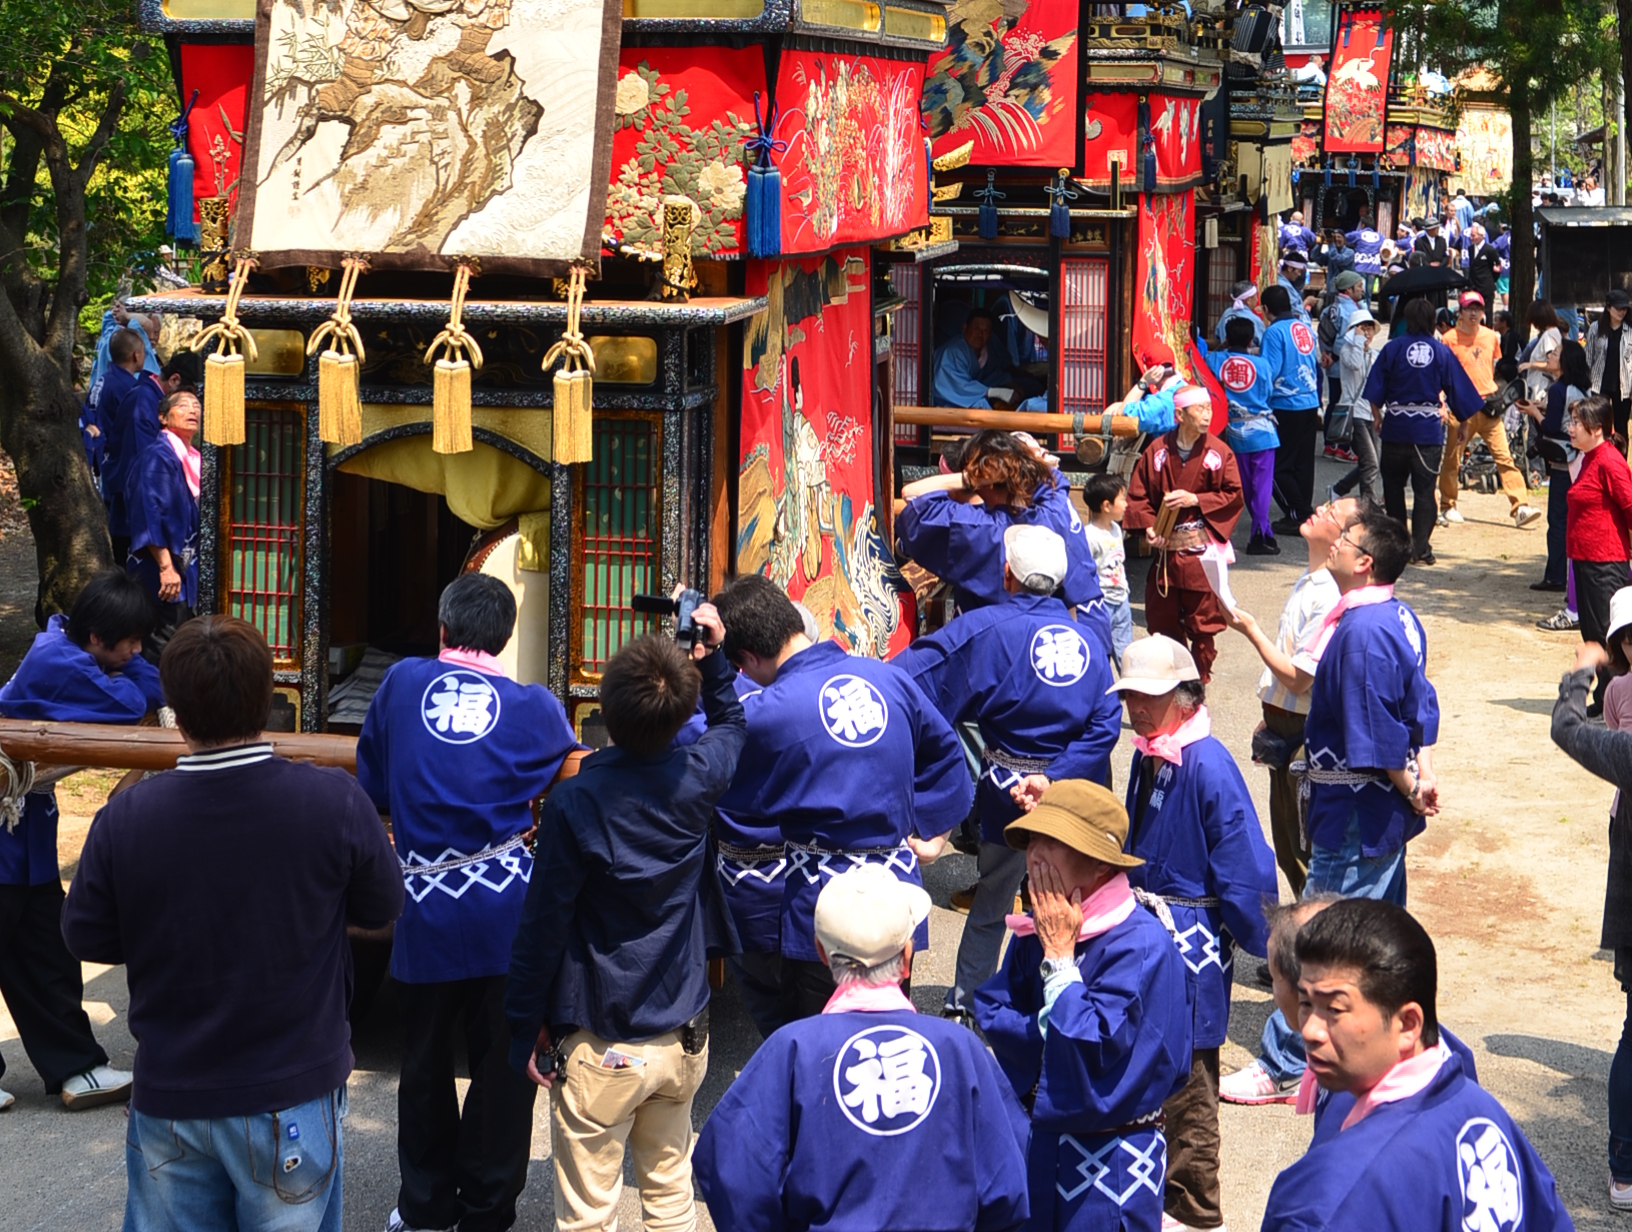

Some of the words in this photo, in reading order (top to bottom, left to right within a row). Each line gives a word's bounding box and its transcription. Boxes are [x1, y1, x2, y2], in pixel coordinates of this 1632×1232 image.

[1226, 362, 1249, 384] 鍋
[1408, 343, 1432, 365] 福
[1036, 630, 1085, 678] 福
[429, 679, 494, 735] 福
[825, 681, 884, 740] 福
[844, 1033, 935, 1124] 福
[1459, 1124, 1518, 1232] 福
